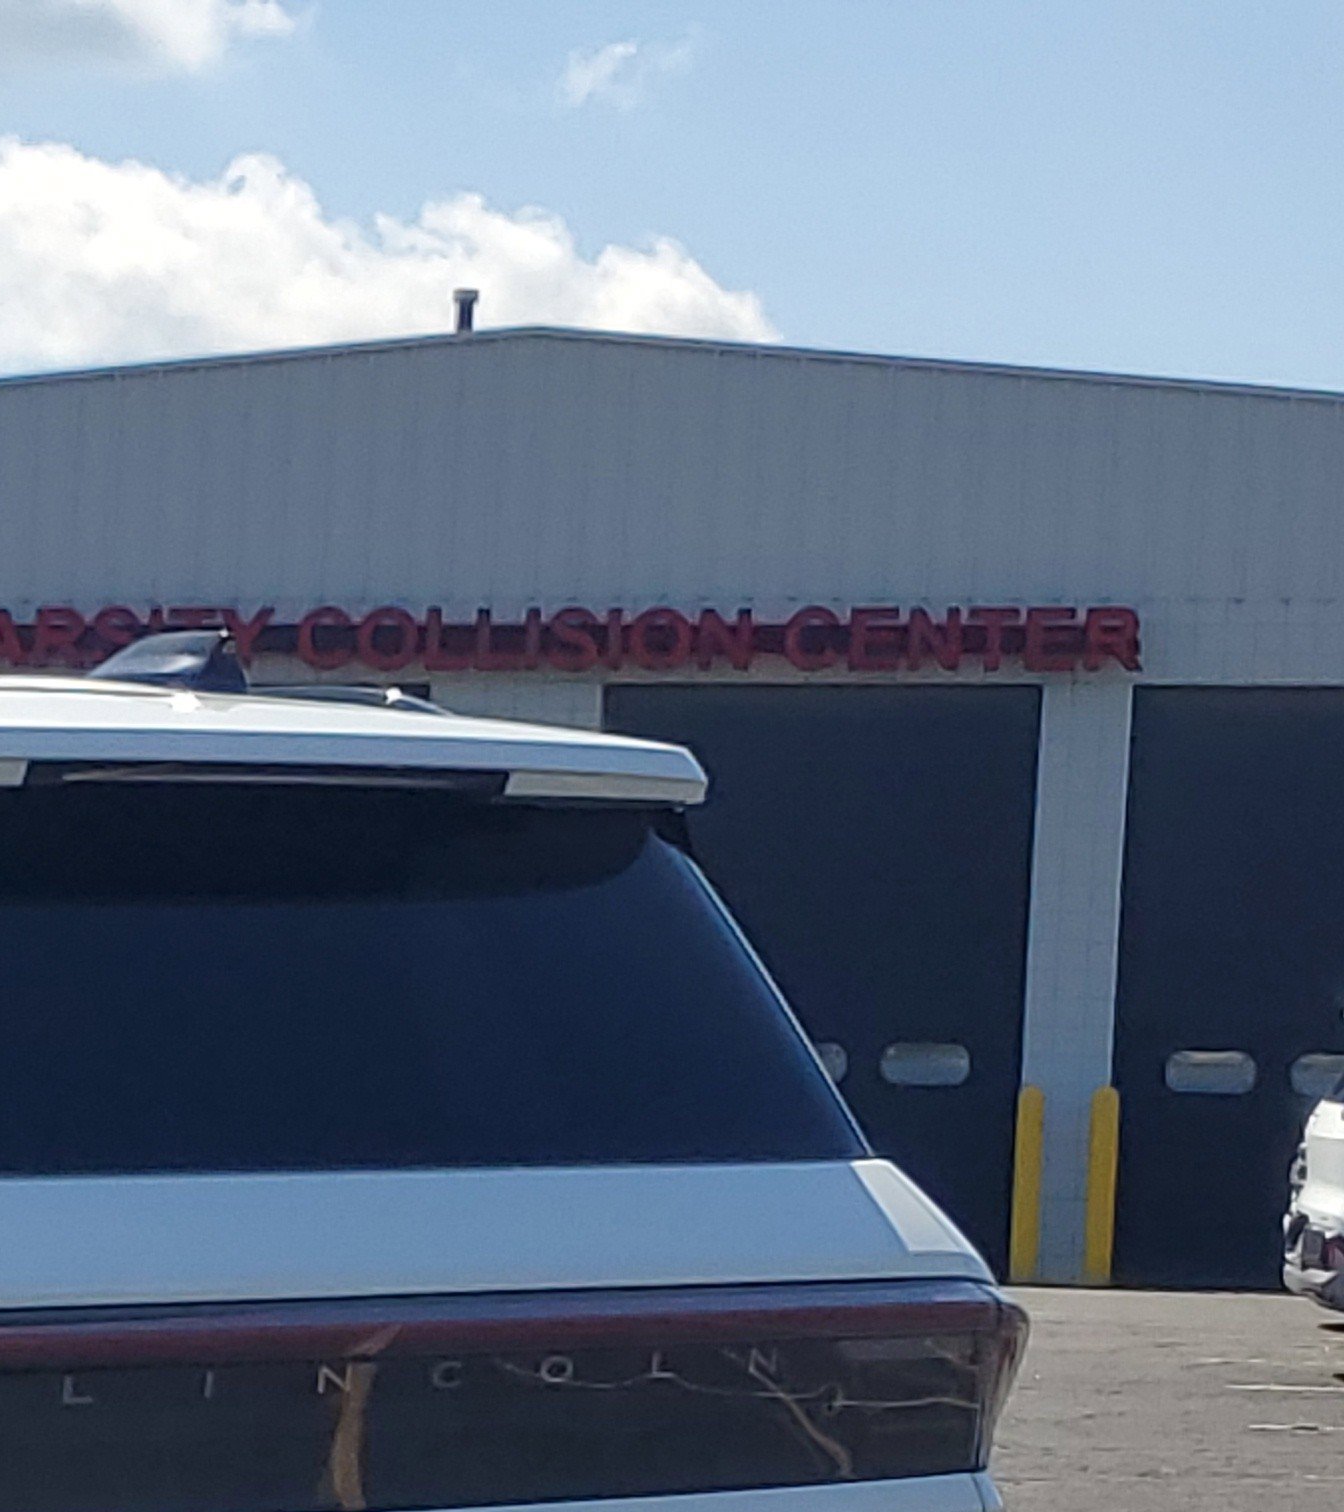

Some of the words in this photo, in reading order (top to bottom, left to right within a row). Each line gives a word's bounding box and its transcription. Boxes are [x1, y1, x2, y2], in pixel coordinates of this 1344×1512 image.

[297, 606, 752, 671] COLLISION
[783, 605, 1143, 673] CENTER
[61, 1349, 781, 1404] LINCOLN
